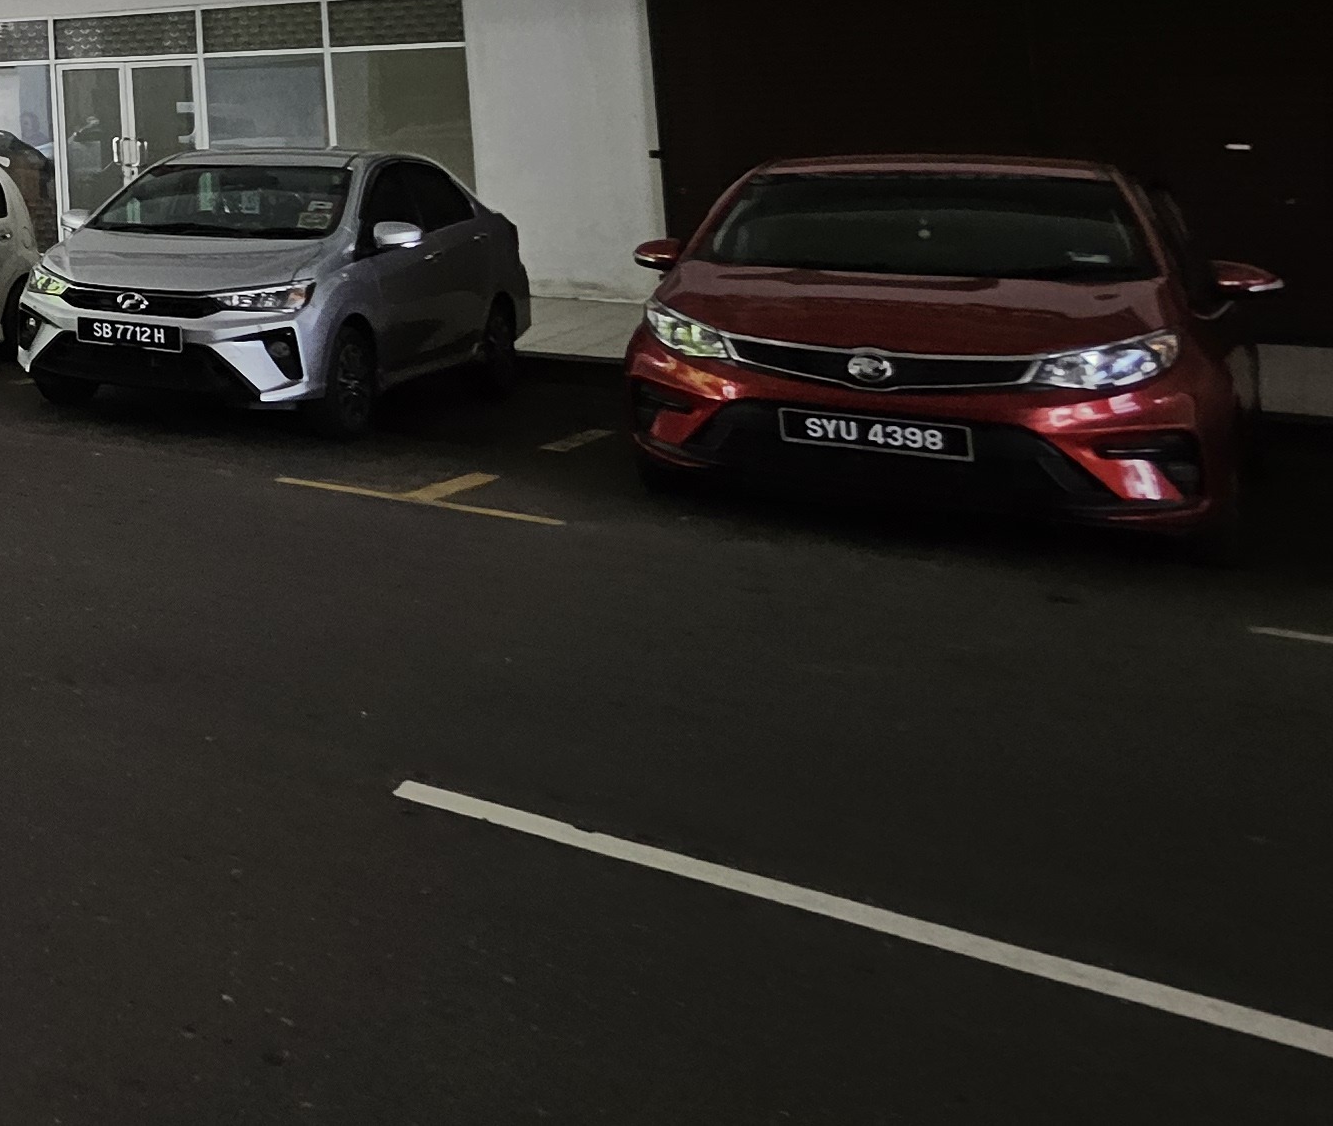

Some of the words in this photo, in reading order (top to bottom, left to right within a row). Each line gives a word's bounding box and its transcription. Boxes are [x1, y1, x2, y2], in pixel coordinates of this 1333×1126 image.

[93, 322, 113, 339] SB
[115, 324, 151, 343] 7712
[154, 328, 165, 344] H
[805, 417, 858, 441] SYU
[868, 424, 943, 450] 4398
